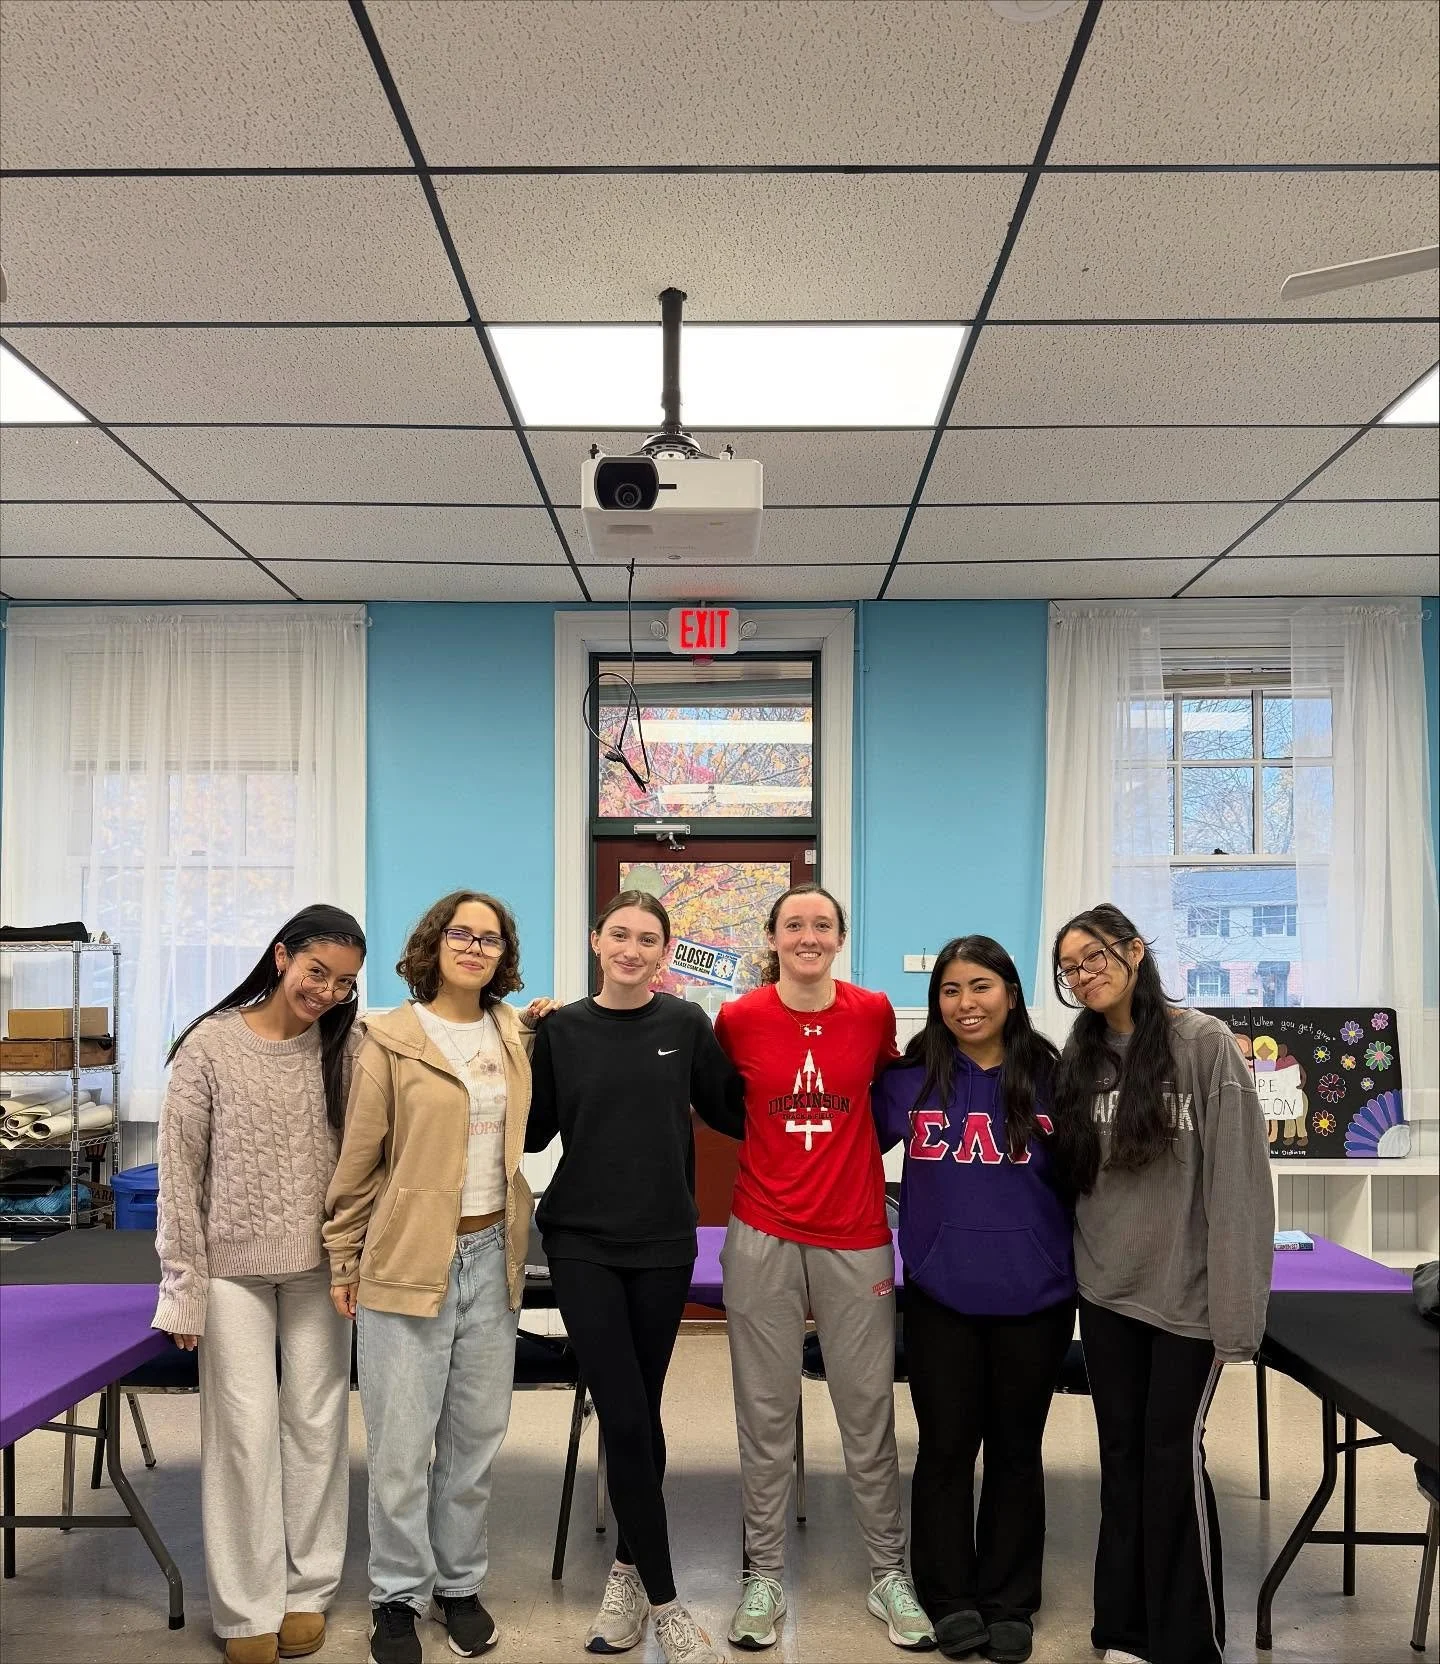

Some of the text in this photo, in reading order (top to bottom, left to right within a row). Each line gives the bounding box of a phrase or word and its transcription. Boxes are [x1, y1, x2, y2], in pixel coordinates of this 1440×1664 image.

[681, 610, 730, 648] EXIT
[674, 943, 715, 969] CLOSED
[1253, 1015, 1274, 1027] When
[1280, 1019, 1295, 1031] you
[1258, 1078, 1278, 1093] PE
[768, 1092, 851, 1116] DICKINSON
[1259, 1097, 1297, 1116] ION
[782, 1112, 805, 1120] TRACK
[814, 1112, 835, 1120] FIELD
